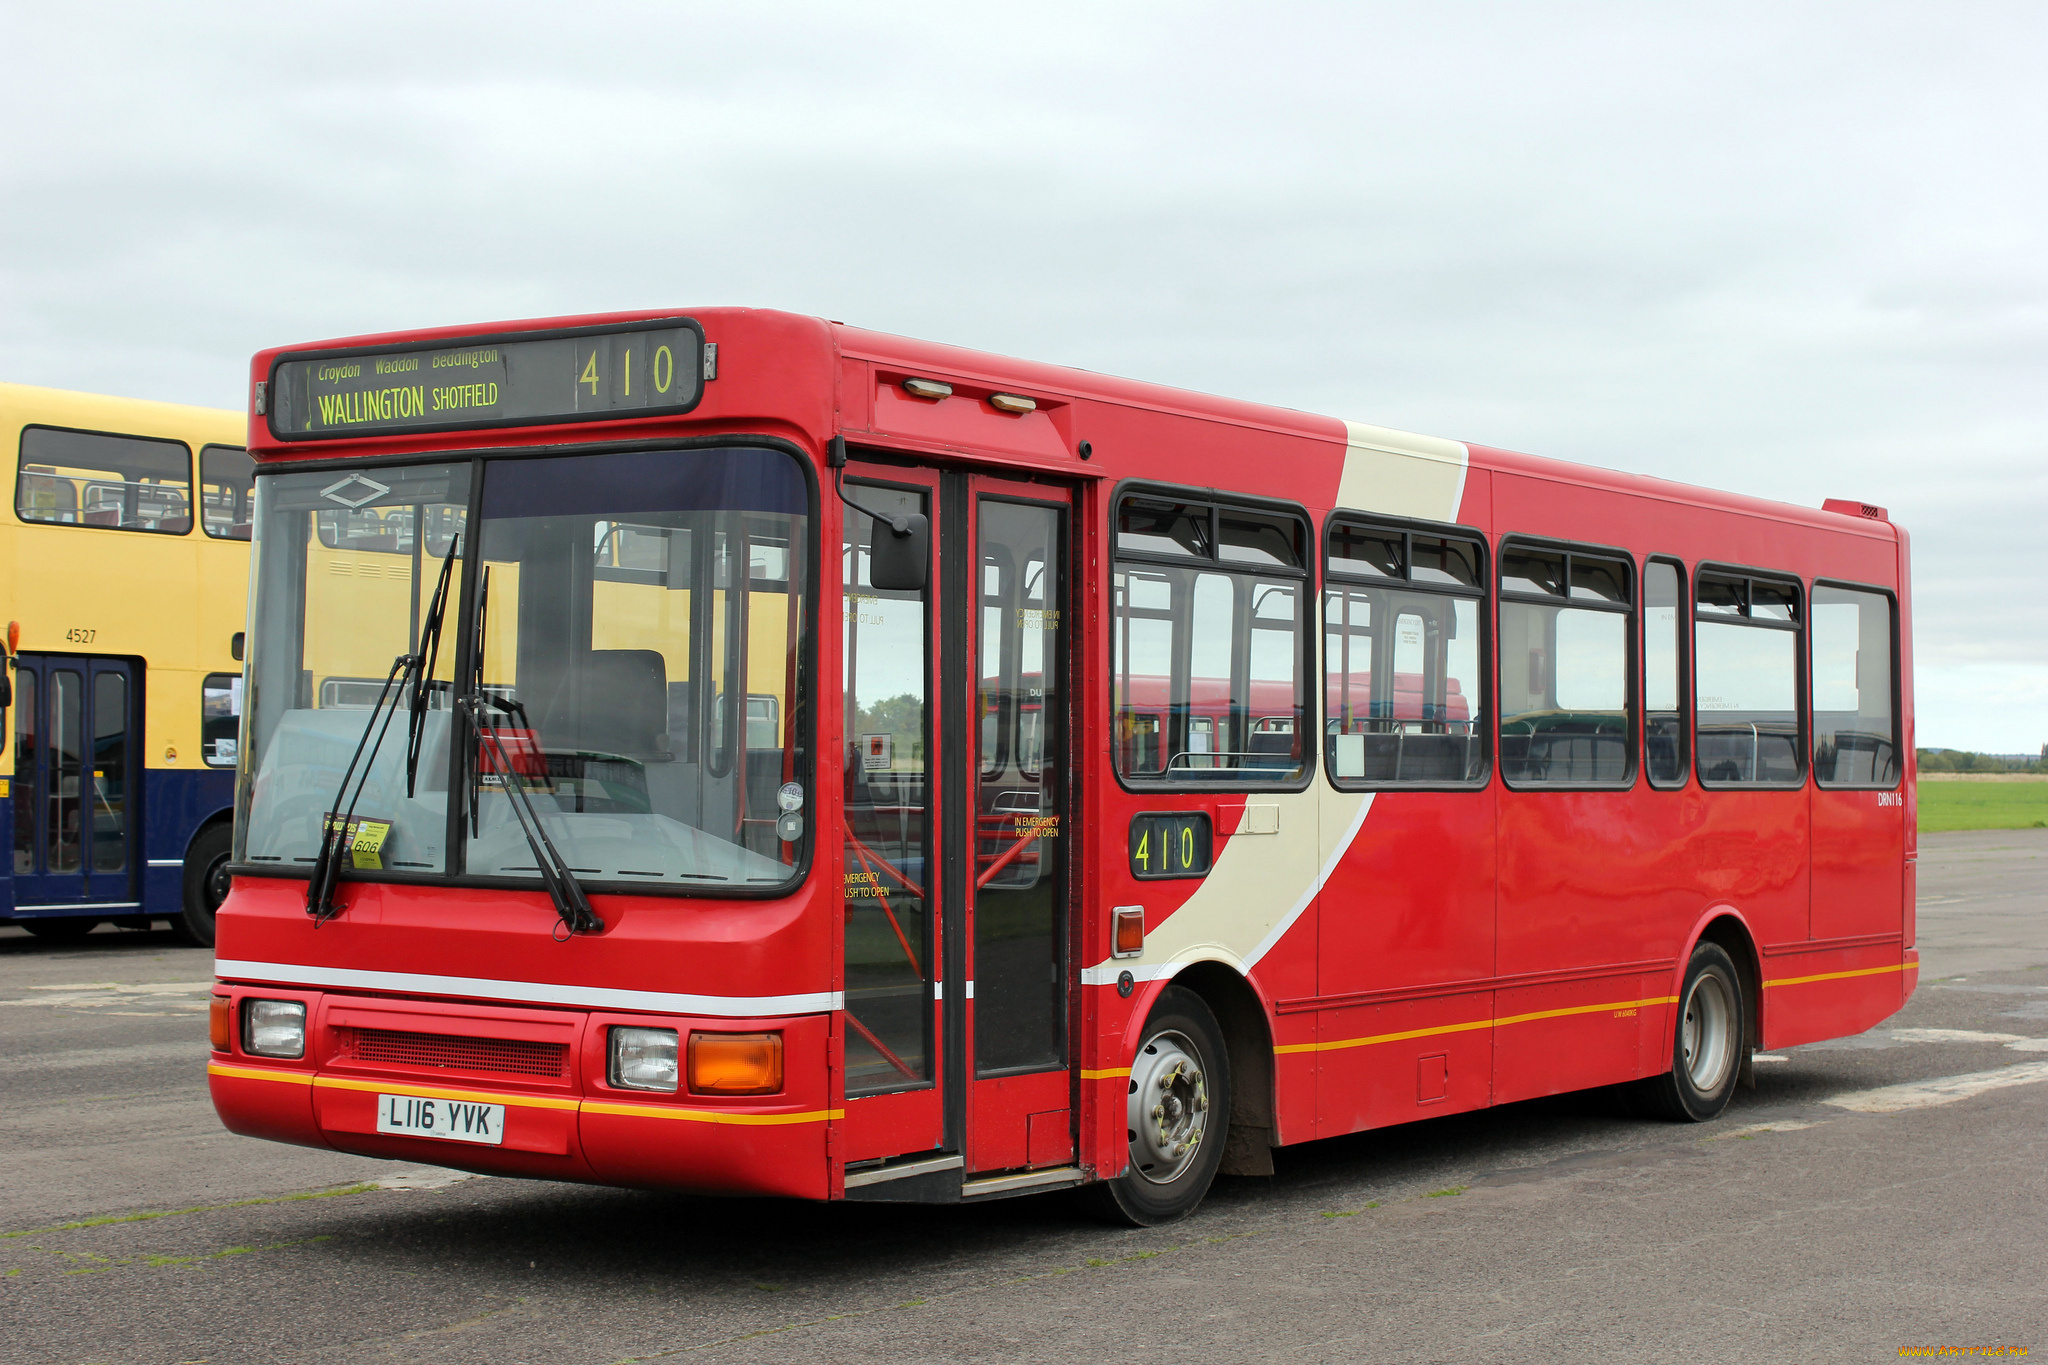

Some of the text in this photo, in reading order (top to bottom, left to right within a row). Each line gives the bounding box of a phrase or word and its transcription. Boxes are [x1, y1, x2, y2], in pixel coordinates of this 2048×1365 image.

[318, 349, 498, 385] Croydon Waddon Beddington
[318, 382, 498, 426] WALLINGTON SHOTFIELD
[66, 628, 96, 644] 4527
[1878, 792, 1903, 807] DRN116
[1014, 816, 1060, 827] IN EMERGENCY
[1015, 827, 1059, 838] PUSH TO OPEN
[354, 840, 379, 854] 606
[1135, 827, 1194, 871] 410
[844, 886, 890, 898] USH TO OPEN
[390, 1098, 492, 1135] L116 YVK
